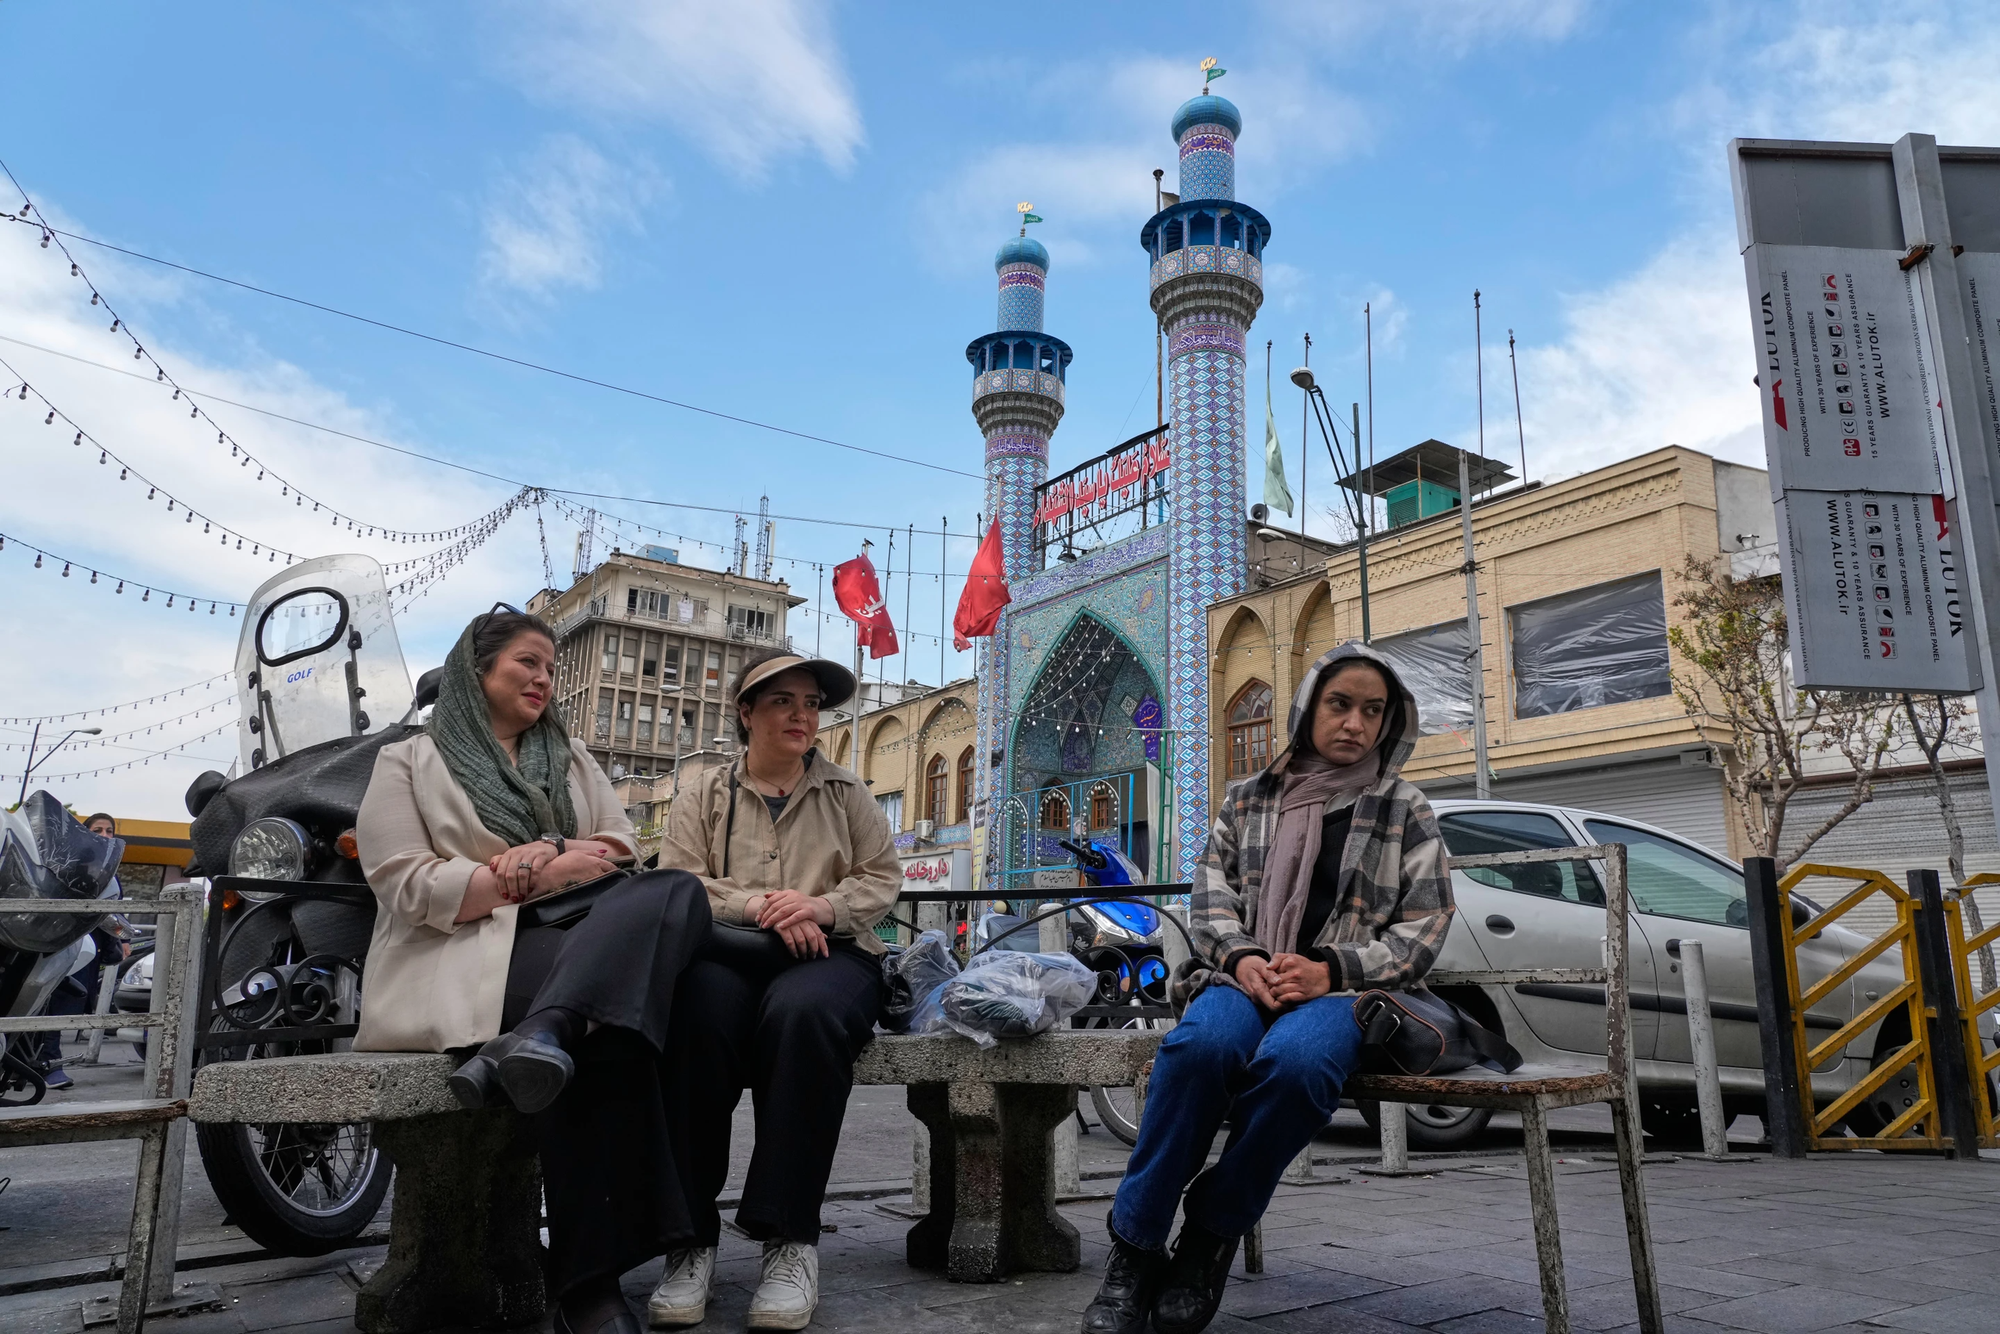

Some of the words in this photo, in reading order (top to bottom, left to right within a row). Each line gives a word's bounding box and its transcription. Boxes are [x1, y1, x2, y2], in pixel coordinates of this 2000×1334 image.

[1781, 270, 1789, 291] PANEL
[1784, 293, 1795, 330] COMPOSITE
[1845, 274, 1858, 321] ASSURANCE
[1907, 294, 1918, 331] SARBOLAND
[1807, 312, 1818, 352] EXPERIENCE
[1973, 300, 1984, 339] COMPOSITE
[1789, 332, 1799, 367] ALUMINUM
[1853, 324, 1862, 349] YEARS
[1913, 333, 1923, 362] FOROZAN
[1813, 354, 1820, 363] OF
[1865, 313, 1890, 418] WWW.ALUTOK.ir
[1979, 339, 1990, 375] ALUMINUM
[1794, 368, 1803, 396] QUALITY
[1814, 365, 1823, 387] YEARS
[1918, 363, 1930, 405] ACCESSORIES
[1985, 375, 1996, 403] QUALITY
[1860, 372, 1872, 417] GUARANTY
[1800, 417, 1811, 457] PRODUCING
[1842, 440, 1857, 455] PPG
[1867, 420, 1876, 447] YEARS
[1871, 451, 1878, 459] 15
[1845, 501, 1857, 548] GUARANTY
[1826, 499, 1853, 615] WWW.ALUTOK.ir
[1896, 533, 1904, 556] YEARS
[1853, 561, 1859, 569] 10
[1899, 558, 1906, 567] OF
[1854, 573, 1863, 601] YEARS
[1900, 570, 1912, 615] EXPERIENCE
[1915, 522, 1925, 553] QUALITY
[1920, 554, 1930, 592] ALUMINUM
[1925, 594, 1937, 636] COMPOSITE
[1931, 639, 1940, 662] PANEL
[1858, 605, 1871, 659] ASSURANCE
[287, 667, 313, 683] GOLF
[904, 857, 949, 882] داروخانه
